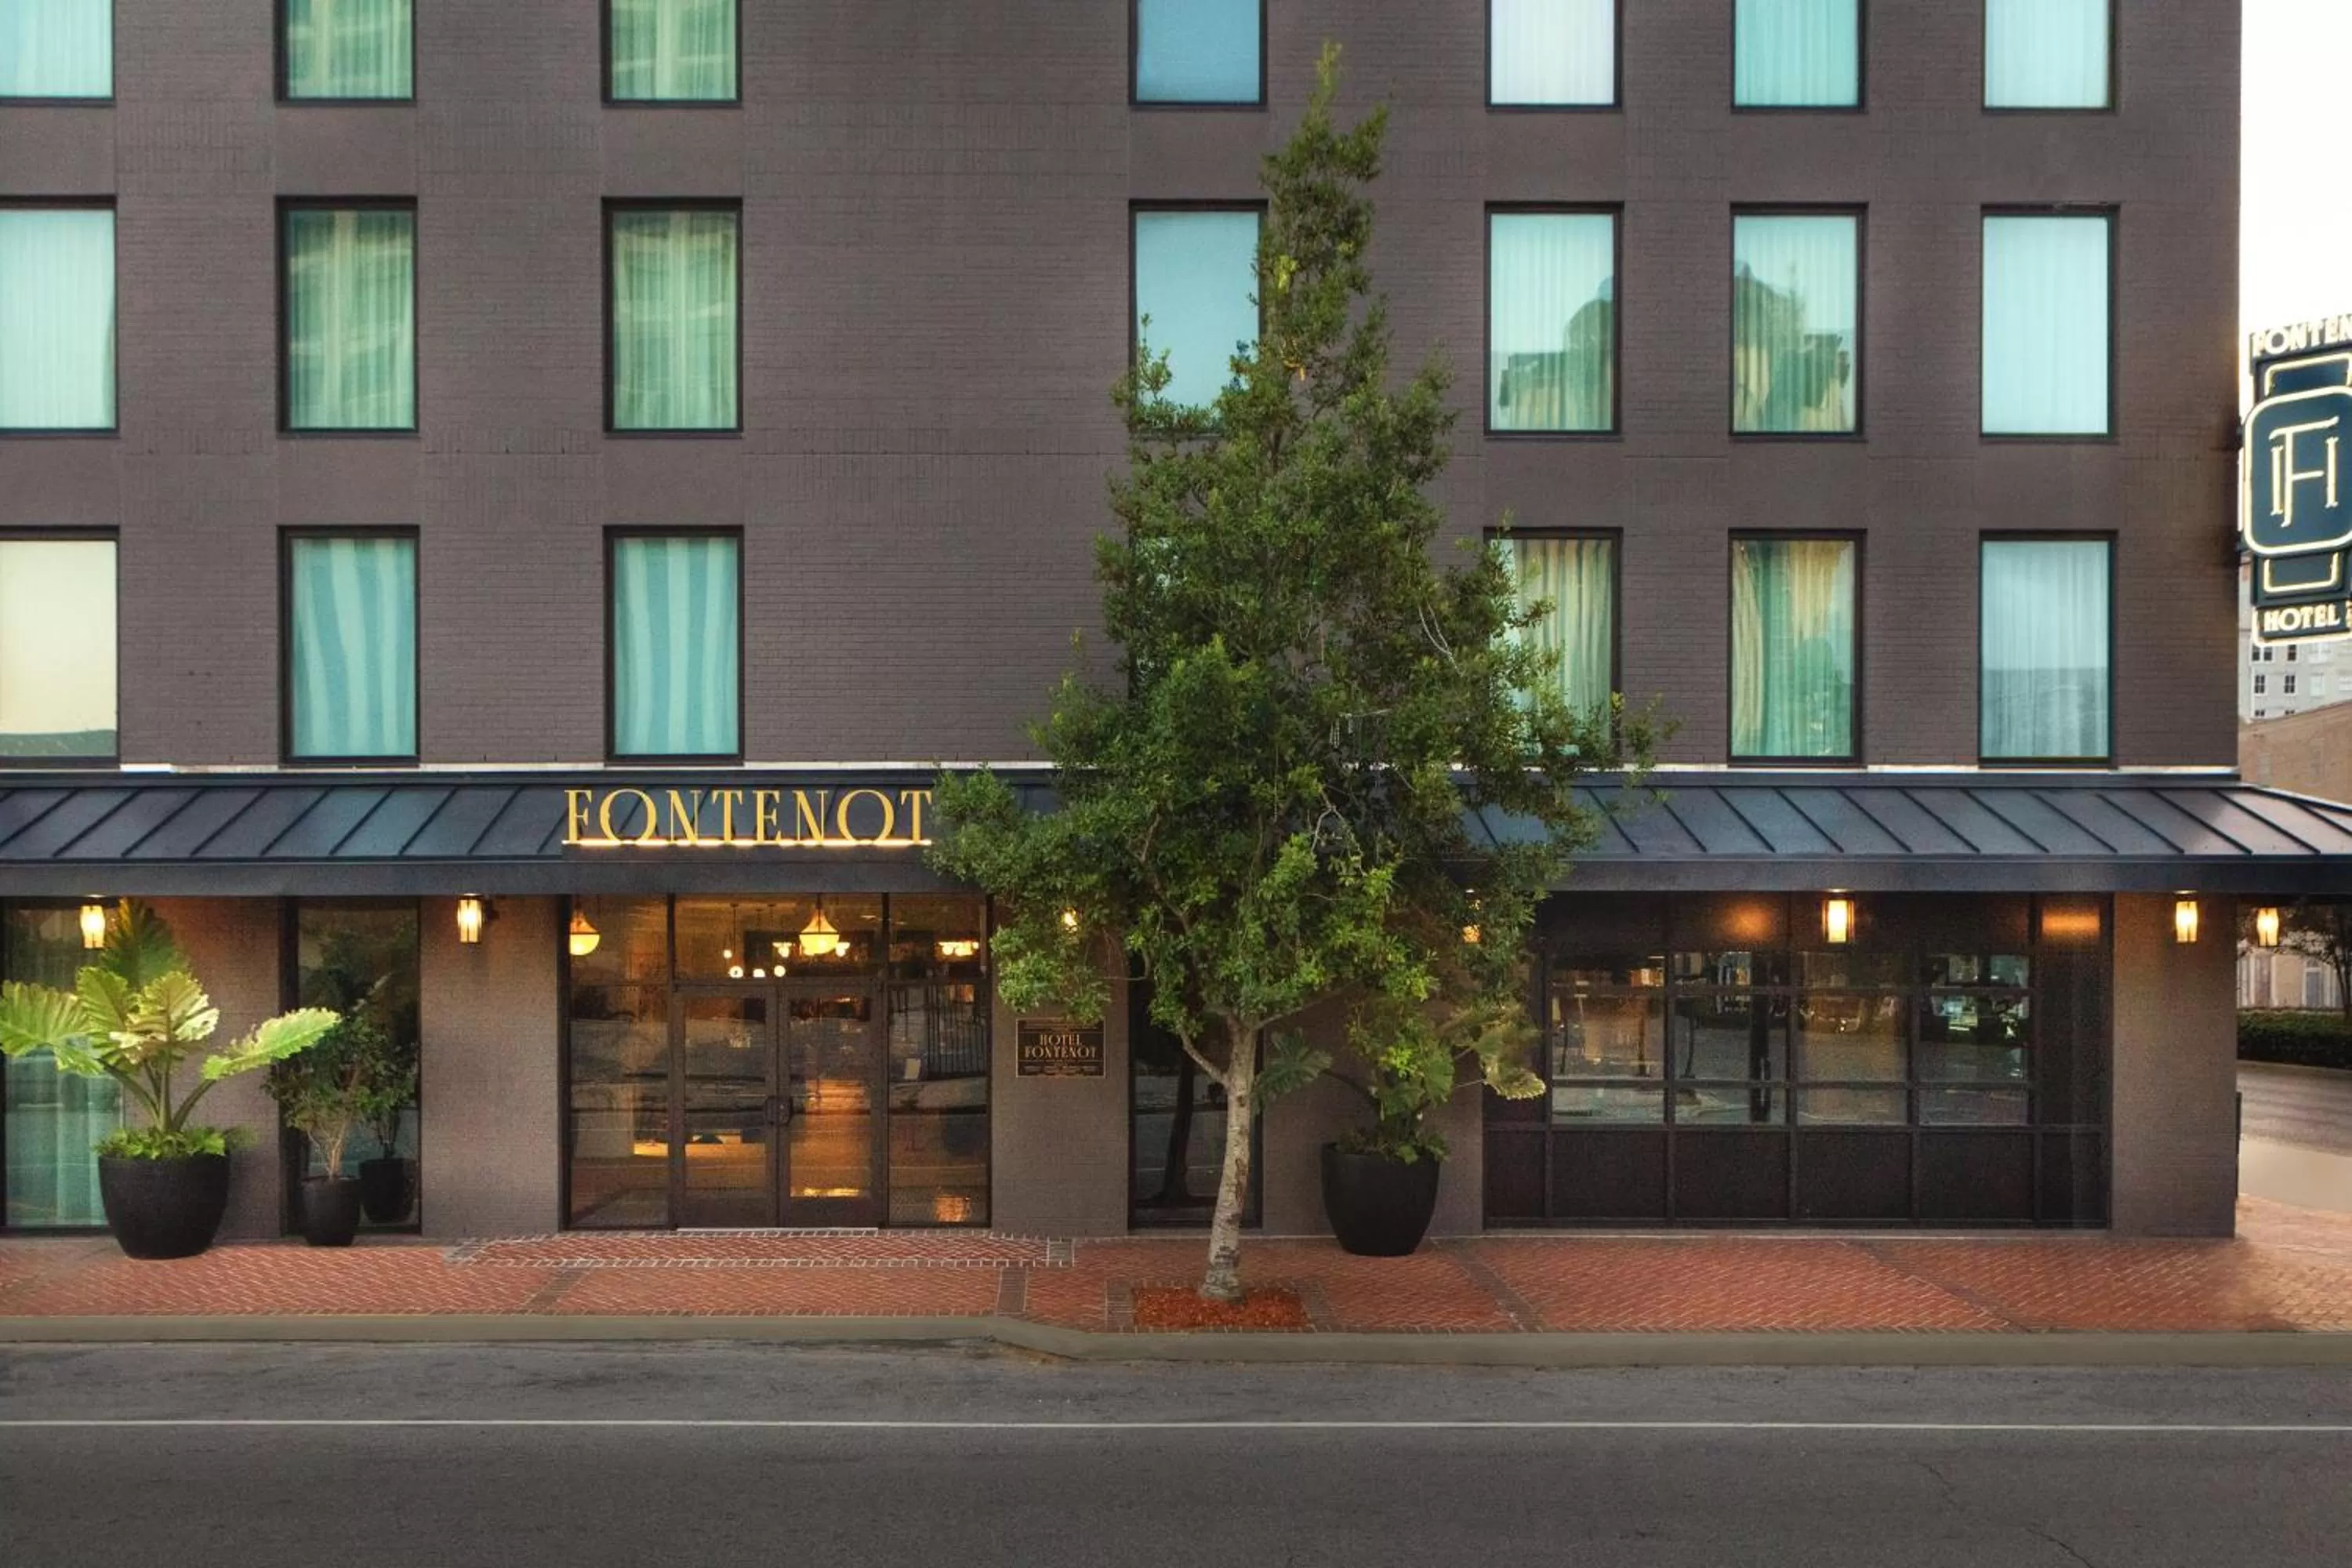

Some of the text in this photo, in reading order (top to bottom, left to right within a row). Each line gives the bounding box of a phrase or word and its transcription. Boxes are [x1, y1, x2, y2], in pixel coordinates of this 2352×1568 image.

[2263, 602, 2340, 632] HOTEL
[563, 789, 932, 843] FONTENOT
[1040, 1034, 1081, 1045] HOTEL
[1025, 1046, 1097, 1058] FONTENOT
